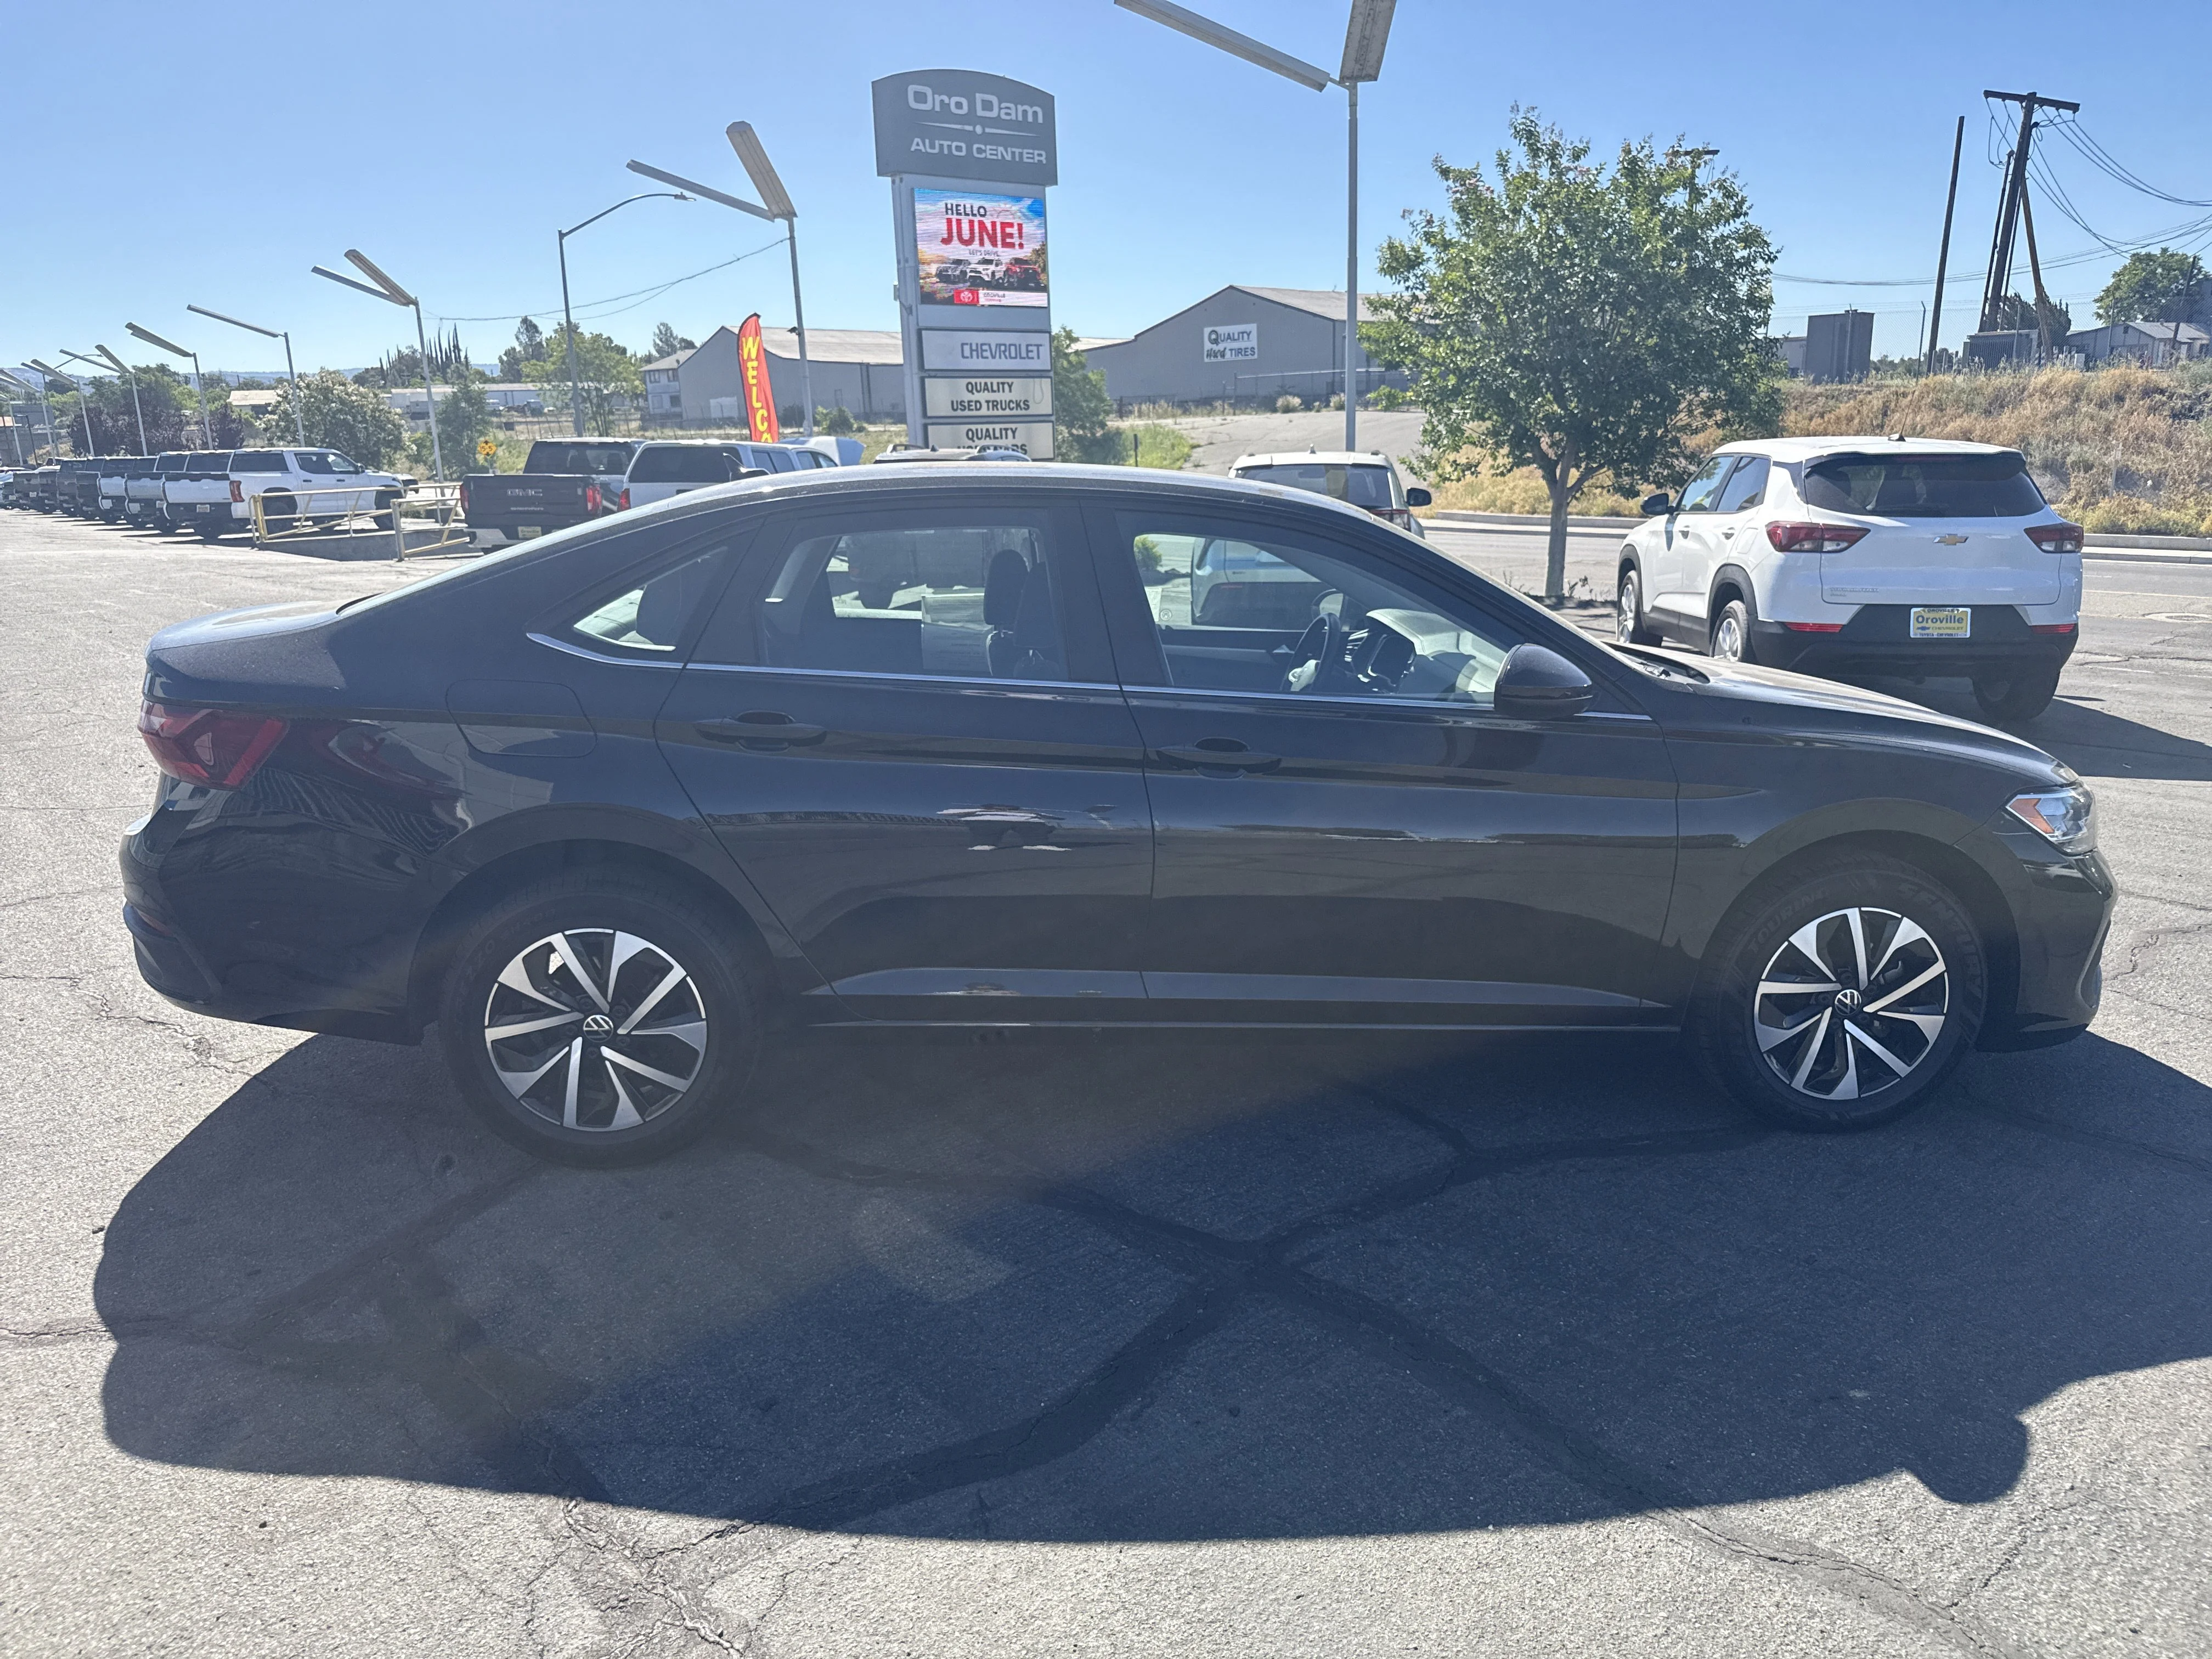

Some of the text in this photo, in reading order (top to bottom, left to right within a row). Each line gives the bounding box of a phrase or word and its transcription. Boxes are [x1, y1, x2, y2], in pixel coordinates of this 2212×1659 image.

[907, 84, 1043, 123] Oro Dam
[910, 138, 1047, 163] AUTO CENTER
[945, 202, 988, 218] HELLO
[940, 218, 1024, 250] JUNE!
[1208, 330, 1252, 346] QUALITY
[961, 342, 1043, 360] CHEVROLET
[1228, 347, 1256, 357] TIRES
[966, 381, 1014, 395] QUALITY
[951, 399, 1030, 411] USED TRUCKS
[966, 427, 1018, 442] QUALITY
[1916, 614, 1964, 624] Oroville
